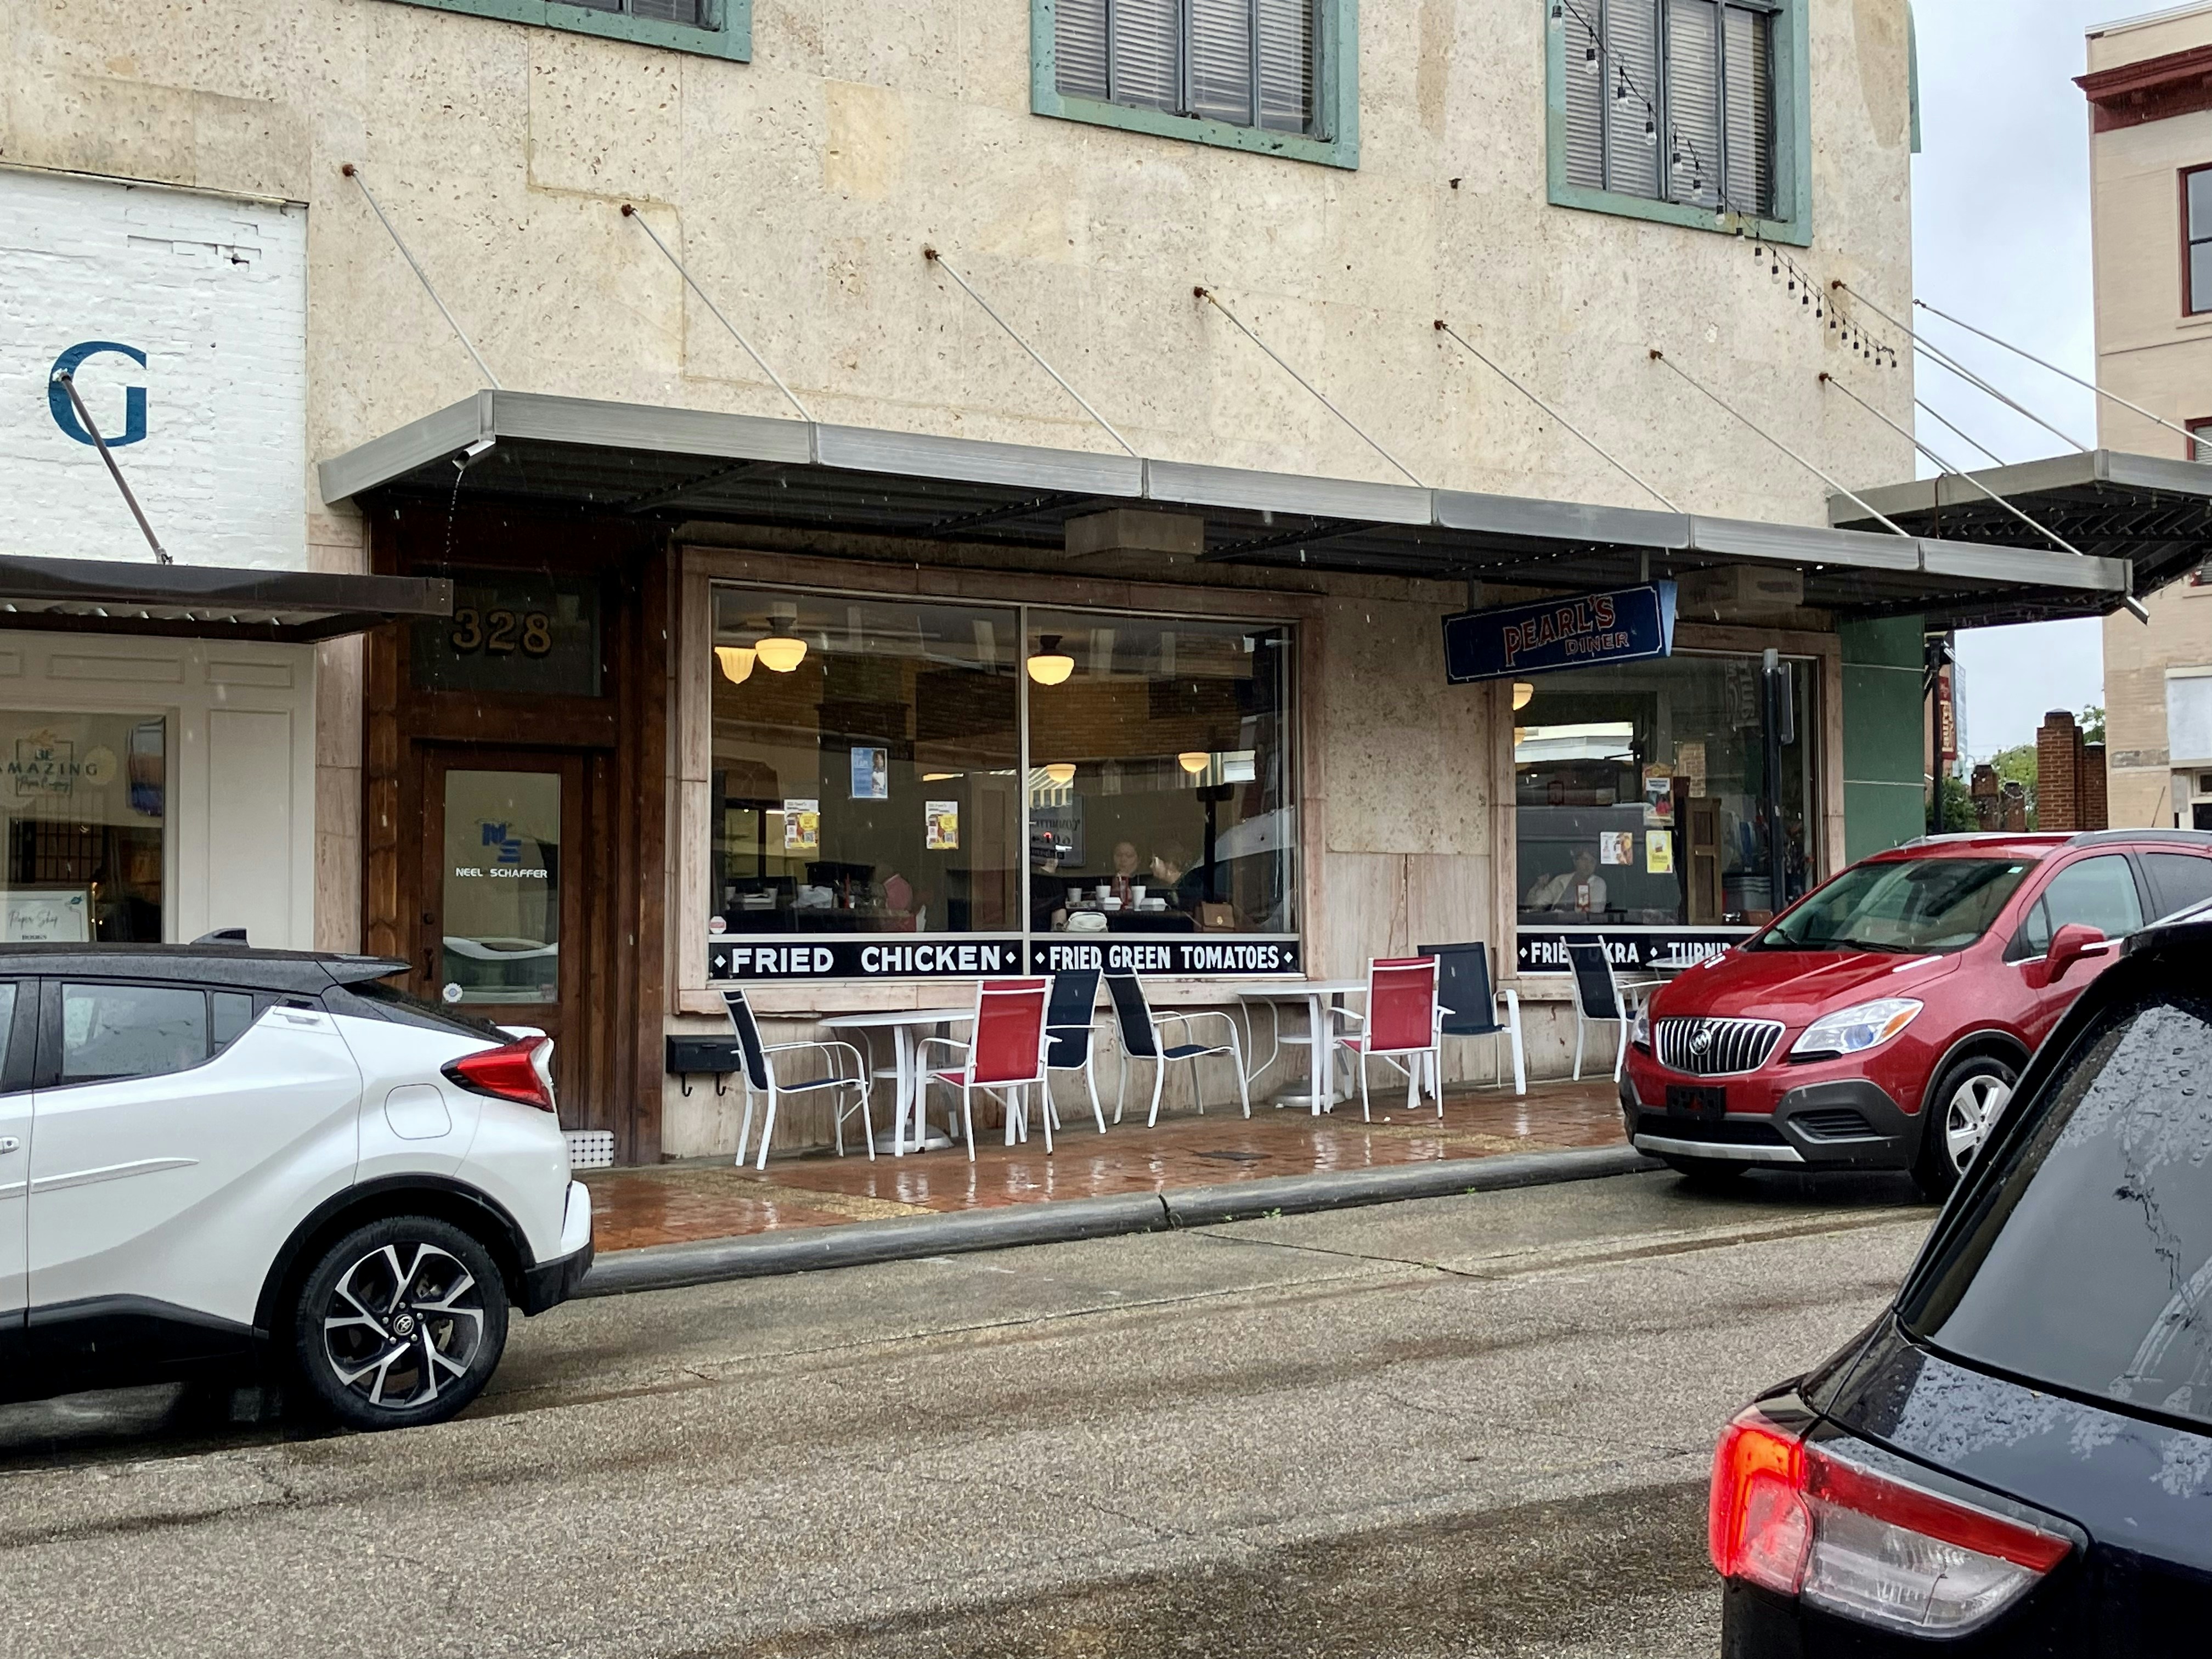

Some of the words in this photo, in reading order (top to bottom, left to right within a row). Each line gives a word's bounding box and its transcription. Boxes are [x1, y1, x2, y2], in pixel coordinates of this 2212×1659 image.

[48, 340, 148, 448] G
[452, 607, 552, 655] 328
[1503, 593, 1616, 667] PEARL'S
[1565, 631, 1630, 656] DINER
[455, 867, 483, 877] NEEL
[489, 868, 548, 879] SCHAFFER
[732, 948, 834, 973] FRIED
[861, 945, 1000, 972] CHICKEN
[1049, 946, 1102, 970] FRIED
[1109, 945, 1171, 969] GREEN
[1181, 946, 1279, 969] TOMATOES
[1531, 942, 1579, 963] FRIE
[1588, 942, 1639, 963] KRA
